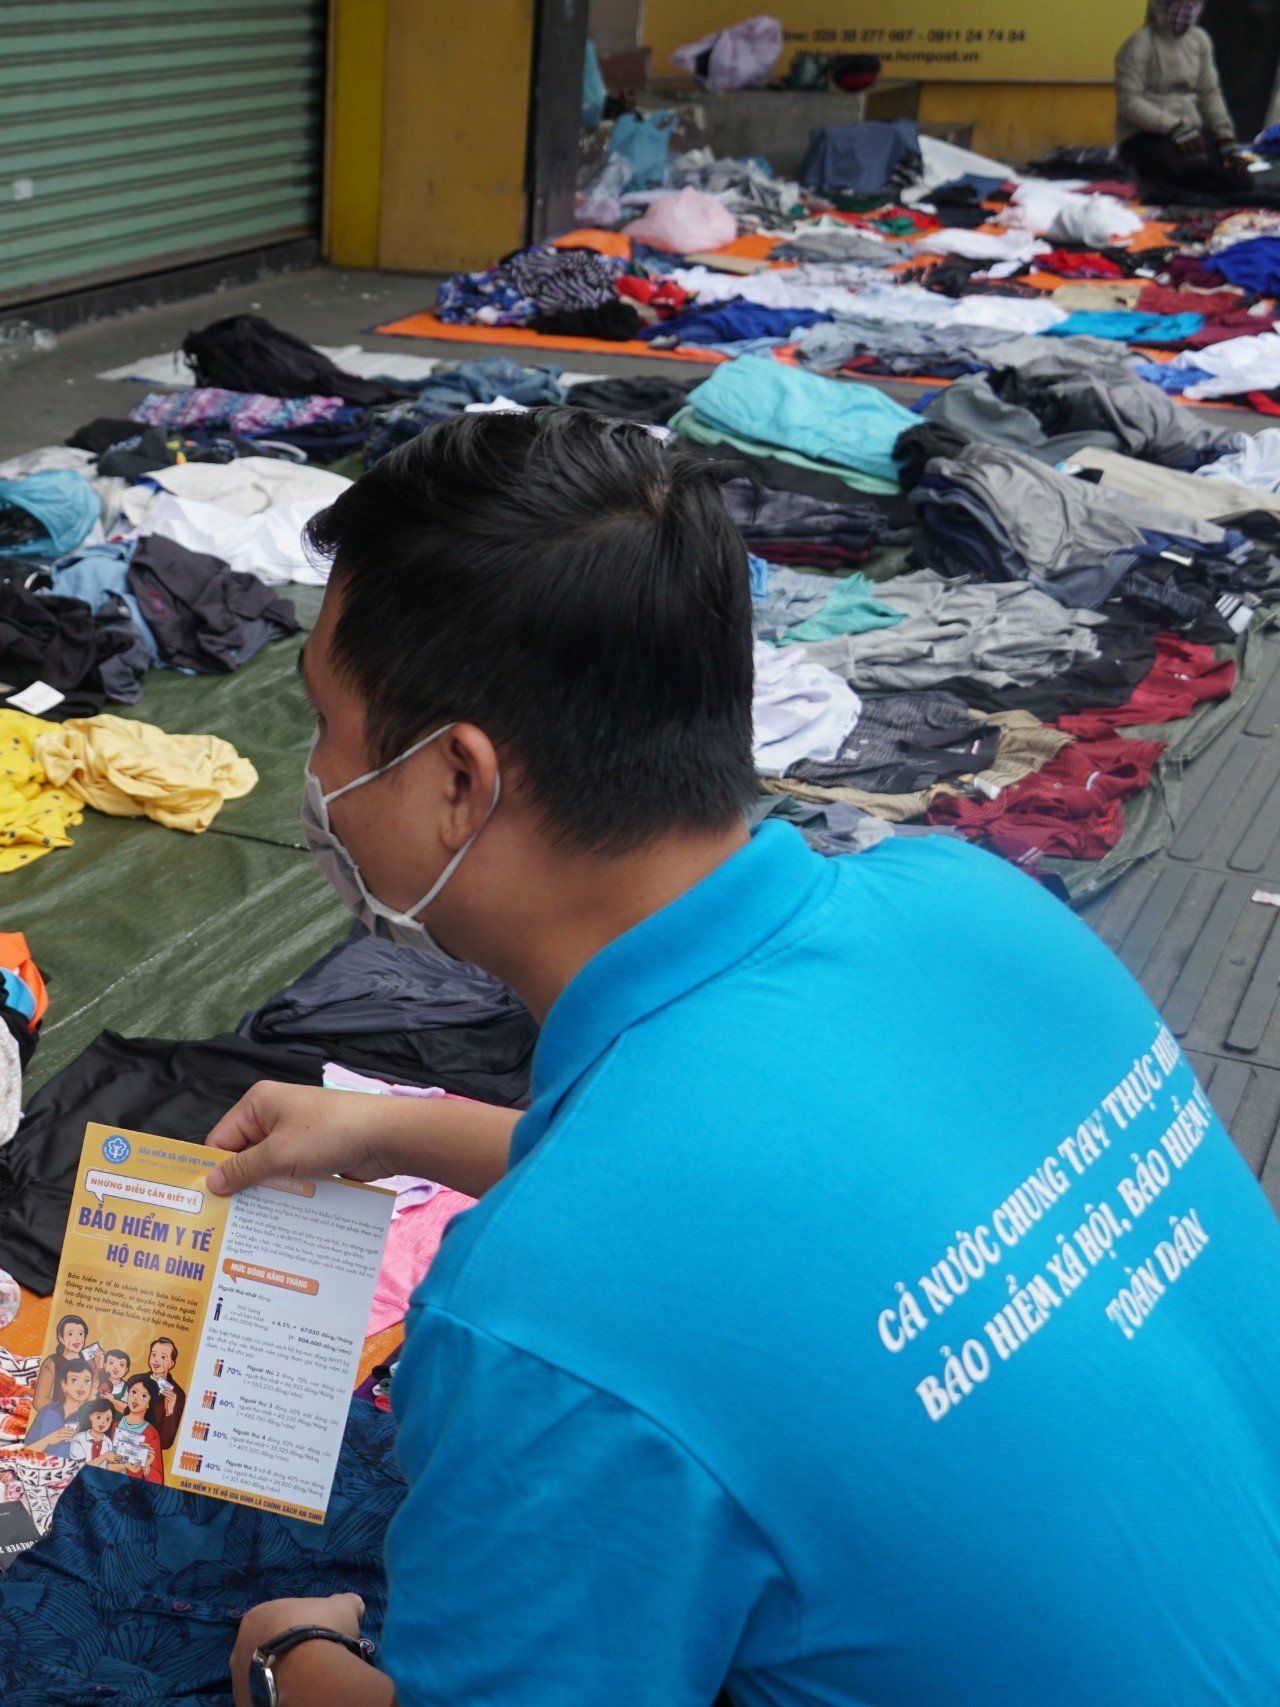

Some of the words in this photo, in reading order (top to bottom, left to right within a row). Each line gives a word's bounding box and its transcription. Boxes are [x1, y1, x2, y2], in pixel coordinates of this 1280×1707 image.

[878, 1281, 929, 1354] CẢ
[918, 1225, 1002, 1315] NƯỚC
[992, 1156, 1071, 1247] CHUNG
[1057, 1109, 1111, 1175] TAY
[1101, 1054, 1163, 1130] THỰC
[79, 1204, 116, 1231] BẢO
[121, 1213, 169, 1242] HIỂM
[175, 1226, 187, 1246] Y
[192, 1227, 215, 1253] TẾ
[106, 1243, 129, 1268] HỘ
[133, 1250, 160, 1271] GIA
[165, 1256, 205, 1281] ĐÌNH
[915, 1345, 990, 1422] BẢO
[983, 1274, 1063, 1361] HIỂM
[1073, 1201, 1133, 1267] HỘI,
[1117, 1149, 1170, 1218] BẢO
[1160, 1095, 1210, 1169] HIỂM
[1106, 1257, 1166, 1340] TOÀN
[1154, 1207, 1210, 1282] DÂN
[226, 1367, 242, 1376] 70%
[219, 1399, 235, 1409] 60%
[212, 1430, 228, 1440] 50%
[205, 1462, 221, 1472] 40%
[5, 1540, 39, 1553] OREVER
